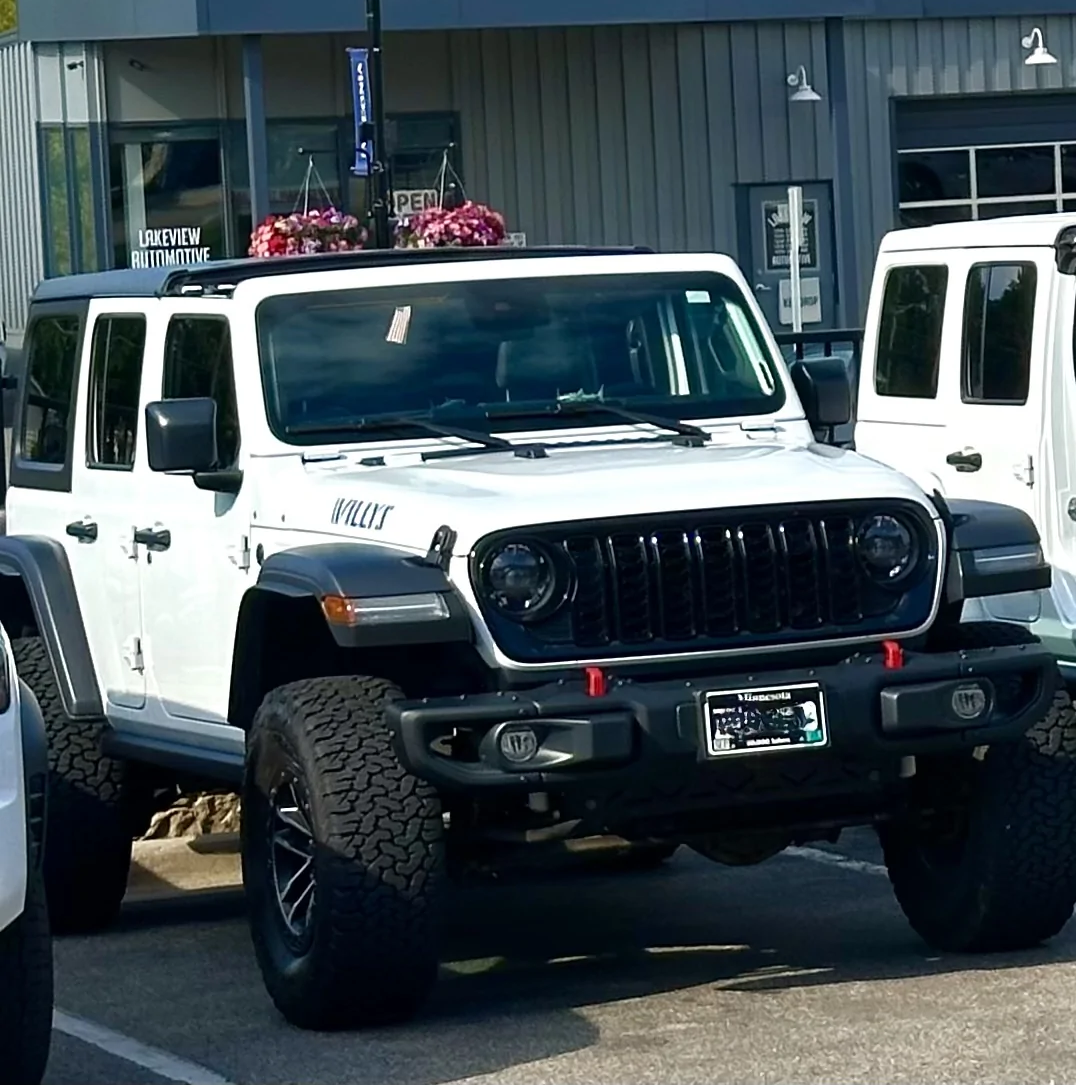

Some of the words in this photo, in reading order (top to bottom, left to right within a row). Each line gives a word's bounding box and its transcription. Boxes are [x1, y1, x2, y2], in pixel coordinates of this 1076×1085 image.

[391, 190, 436, 213] PEN
[139, 227, 200, 248] LAKEVIEW
[131, 247, 210, 269] AUTOMOTIVE
[330, 498, 395, 531] WILLYS
